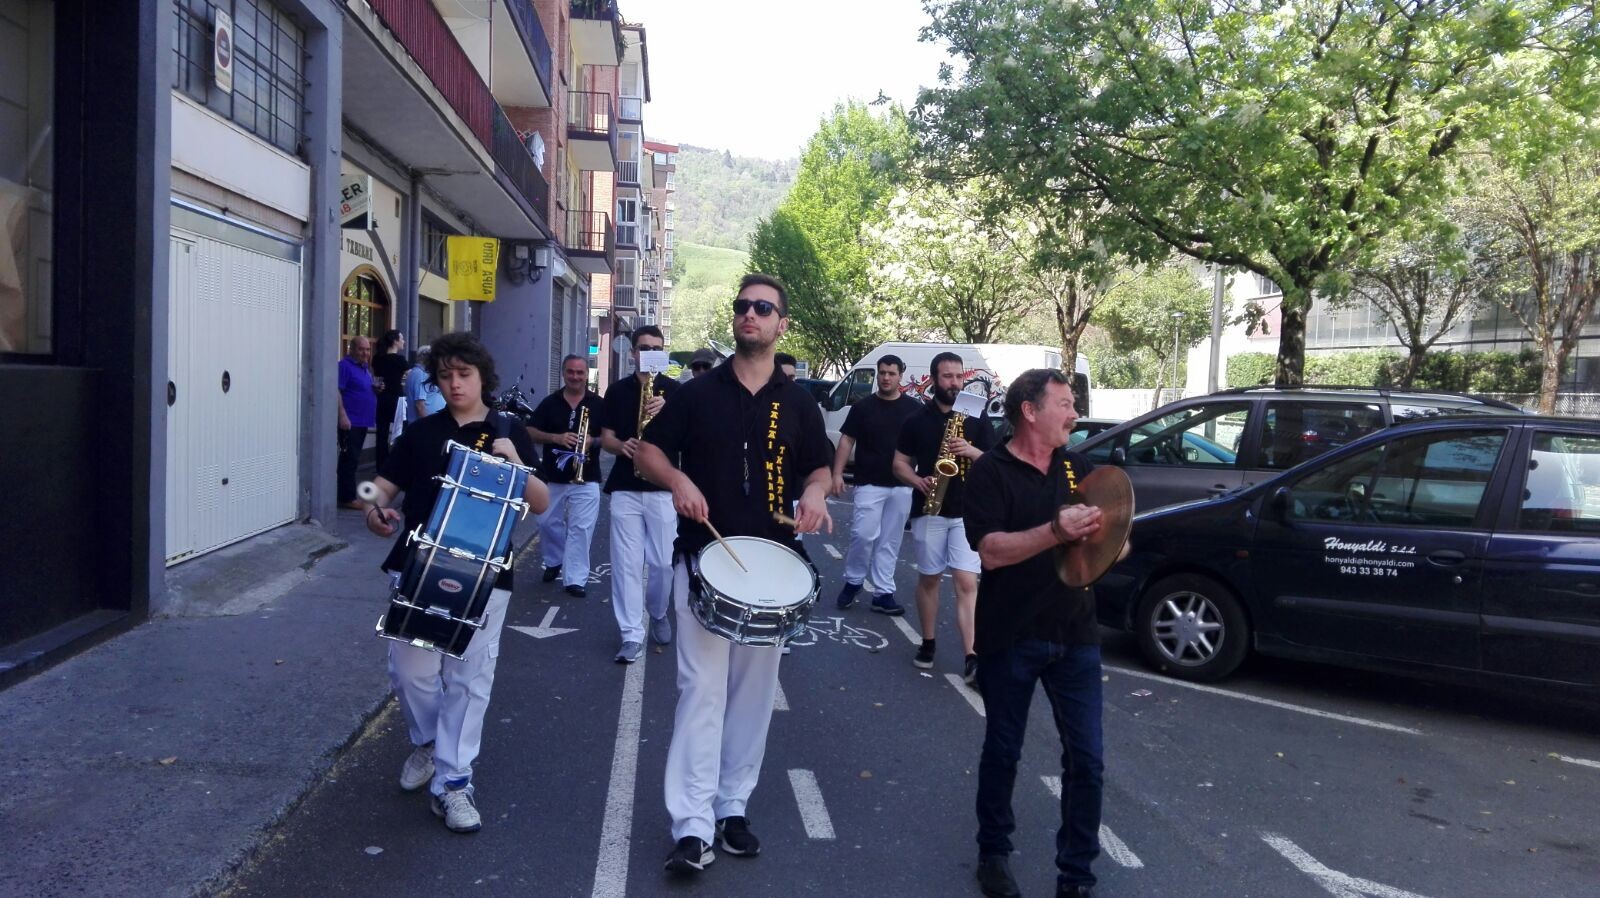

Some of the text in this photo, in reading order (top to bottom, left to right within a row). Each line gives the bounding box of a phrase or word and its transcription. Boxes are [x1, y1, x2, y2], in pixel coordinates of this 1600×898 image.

[341, 183, 363, 203] ER
[765, 402, 780, 512] TALAI MINDI
[1063, 461, 1077, 494] TAL
[1324, 537, 1387, 554] Honyaldi
[1325, 556, 1415, 568] honyaldi@honyaldi.com
[1340, 566, 1398, 577] 943 33 38 74
